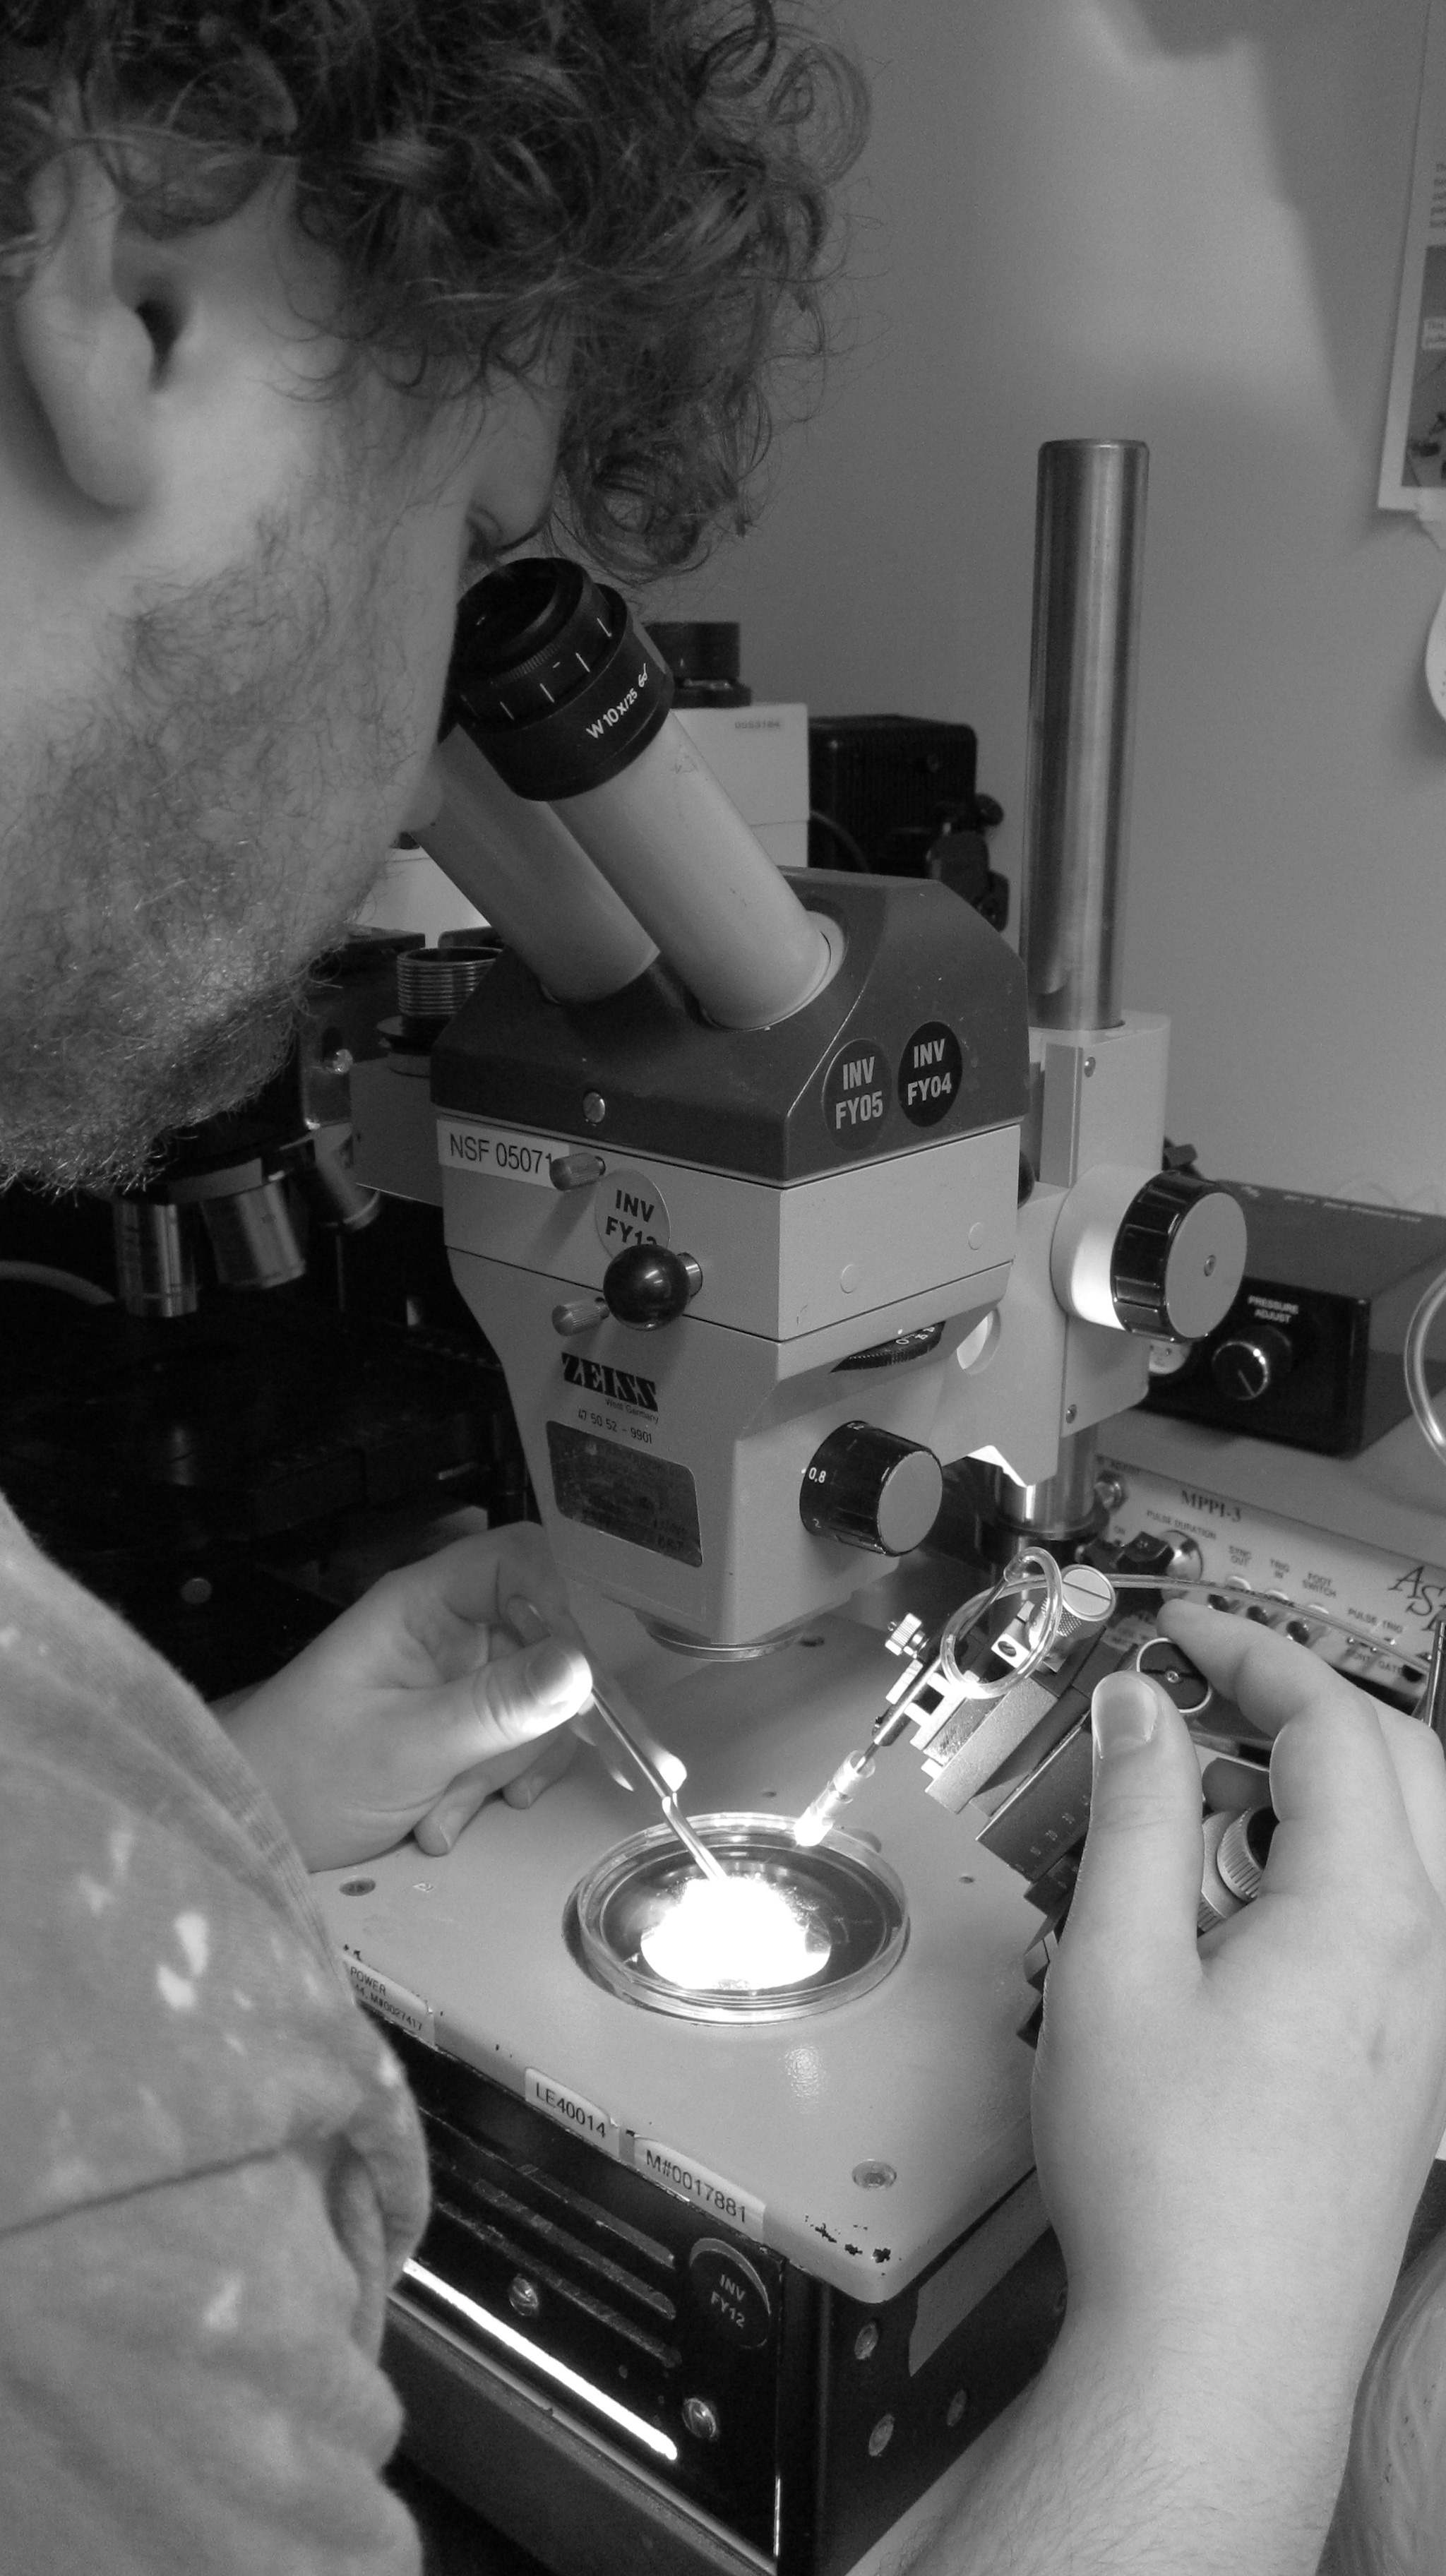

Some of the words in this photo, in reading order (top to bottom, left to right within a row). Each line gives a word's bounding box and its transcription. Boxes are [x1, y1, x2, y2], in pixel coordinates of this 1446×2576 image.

[585, 719, 604, 739] W
[914, 1039, 945, 1068] INV
[842, 1056, 875, 1090] INV
[907, 1072, 952, 1106] FY04
[835, 1090, 883, 1129] FY05
[450, 1133, 489, 1162] NSF
[616, 1189, 655, 1223] INV
[561, 1352, 658, 1412] ZEISS
[590, 1413, 602, 1426] 50
[606, 1418, 617, 1432] 52
[631, 1427, 652, 1444] 9901
[1181, 1489, 1241, 1522] MPPI-3
[1147, 1509, 1171, 1525] PULSE
[1174, 1519, 1217, 1540] DURATION
[350, 1966, 386, 1996] POWER
[536, 2082, 606, 2139] LE40014
[646, 2149, 746, 2223] M#0017881
[720, 2274, 746, 2301] INV
[710, 2291, 745, 2328] FY12
